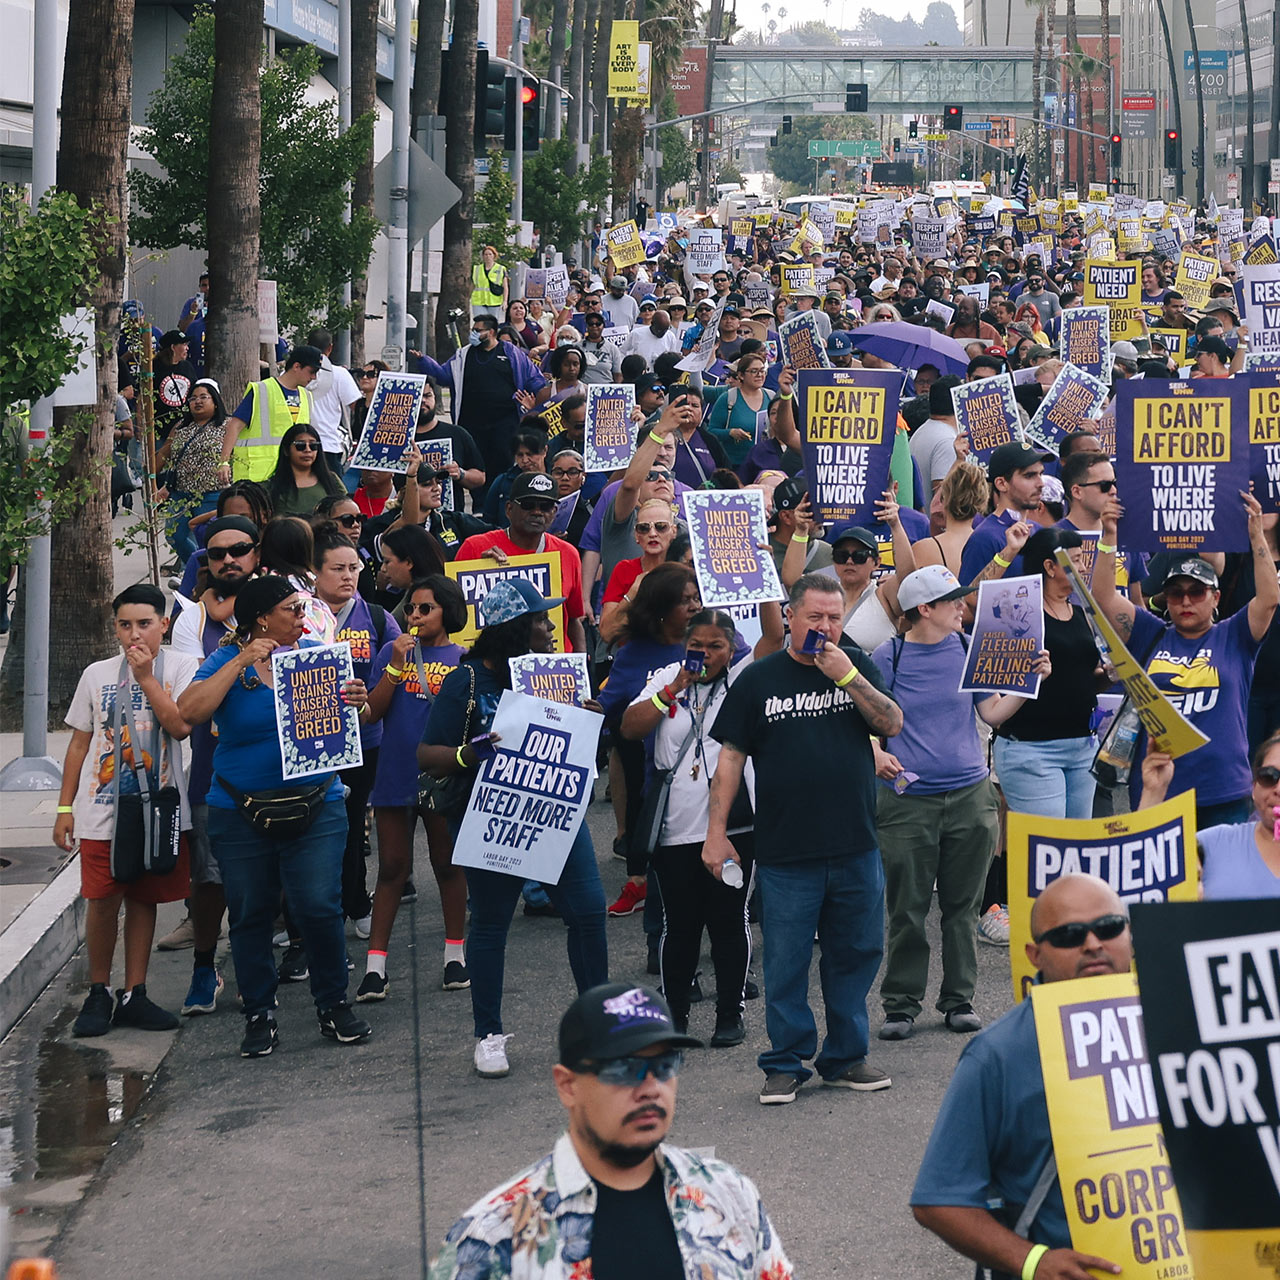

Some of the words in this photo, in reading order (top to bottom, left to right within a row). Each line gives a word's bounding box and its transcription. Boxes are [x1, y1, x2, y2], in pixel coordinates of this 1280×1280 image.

[705, 511, 748, 525] UNITED
[707, 525, 749, 538] AGAINST
[708, 537, 751, 550] KAISER'S
[709, 550, 754, 559] CORPORATE
[712, 558, 757, 574] GREED
[981, 638, 1035, 651] FLEECING
[976, 658, 1032, 672] FAILING
[972, 673, 1028, 687] PATIENTS.
[525, 730, 565, 764] OUR
[489, 753, 580, 798] PATIENTS
[473, 786, 520, 818] NEED
[520, 796, 578, 832] MORE
[483, 818, 543, 851] STAFF
[1158, 1047, 1266, 1128] FOR
